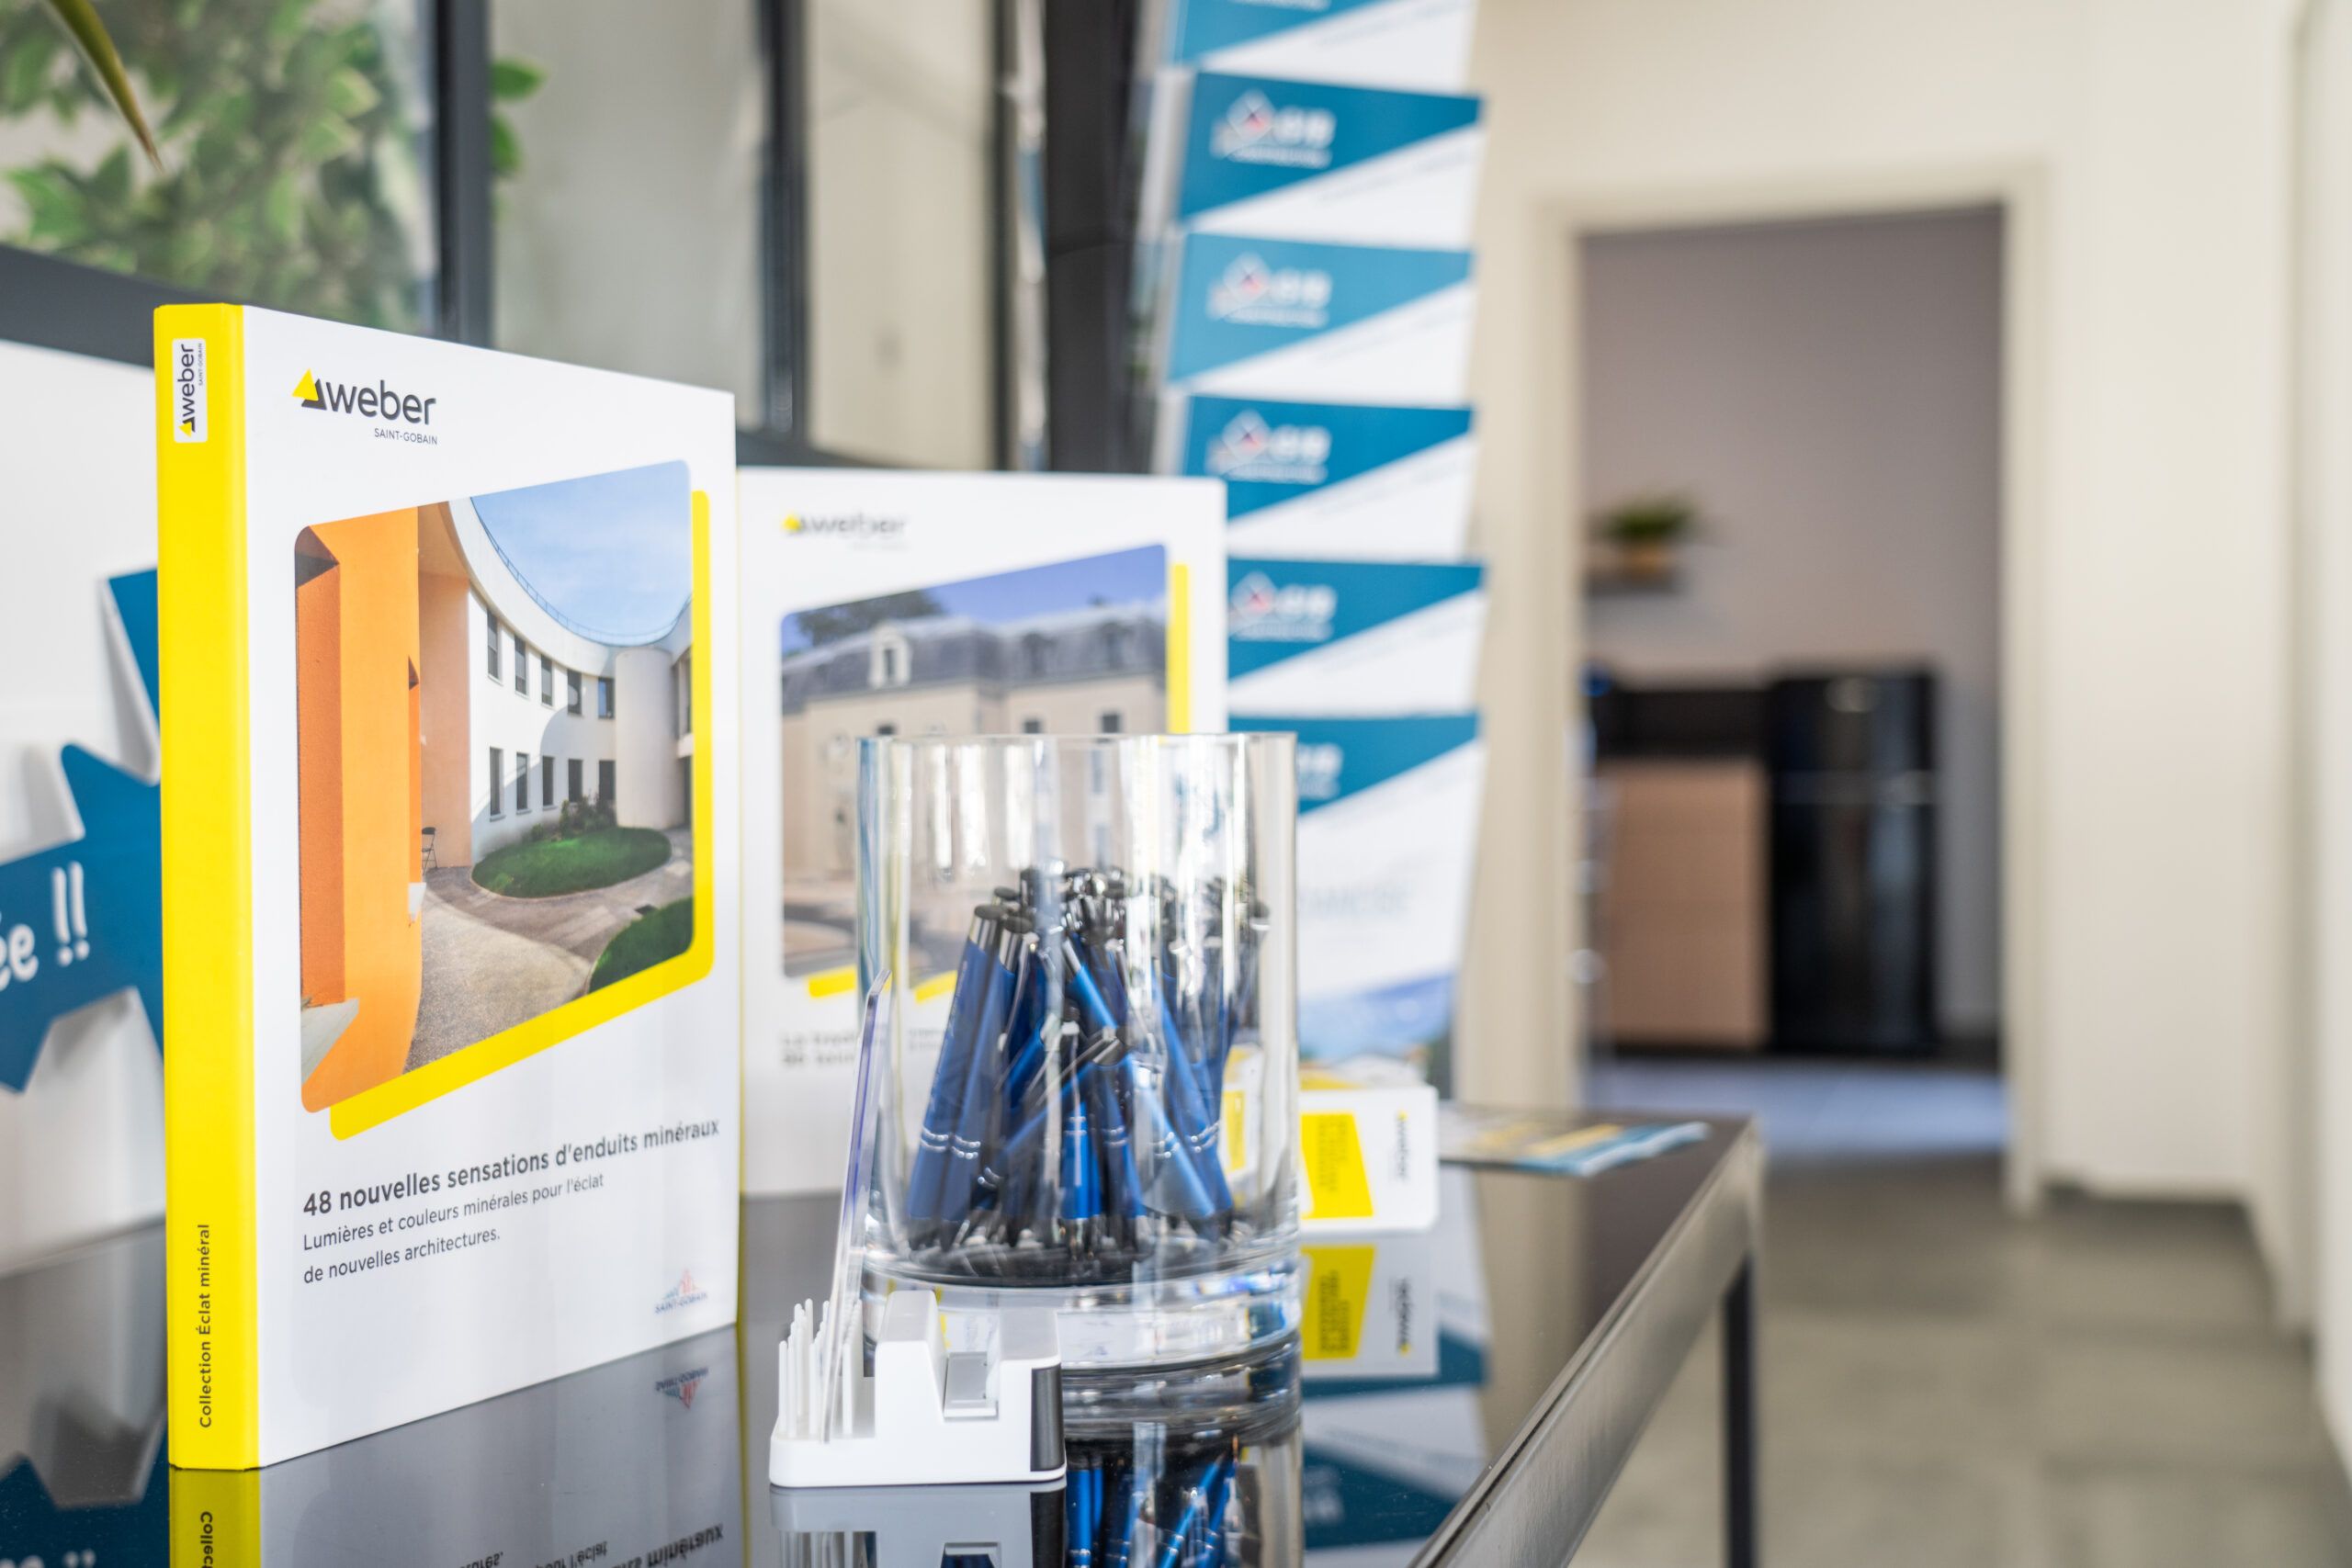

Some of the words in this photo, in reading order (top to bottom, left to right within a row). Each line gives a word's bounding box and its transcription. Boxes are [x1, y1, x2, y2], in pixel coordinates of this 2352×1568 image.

[177, 344, 195, 417] weber
[325, 379, 437, 425] weber
[374, 427, 438, 446] SAINT-GOBAIN
[303, 1190, 333, 1217] 48
[340, 1173, 441, 1211] nouvelles
[447, 1150, 549, 1189] sensations
[555, 1134, 639, 1168] d'enduits
[643, 1118, 719, 1149] minéraux
[303, 1221, 374, 1251] Lumières
[379, 1218, 394, 1235] et
[398, 1204, 459, 1233] couleurs
[463, 1189, 528, 1217] minérales
[532, 1184, 563, 1205] pour
[566, 1172, 604, 1194] l'éclat
[197, 1224, 210, 1287] minéral
[303, 1266, 323, 1285] de
[328, 1248, 401, 1280] nouvelles
[404, 1229, 501, 1261] architectures.
[196, 1293, 210, 1335] Éclat
[198, 1341, 211, 1428] Collection
